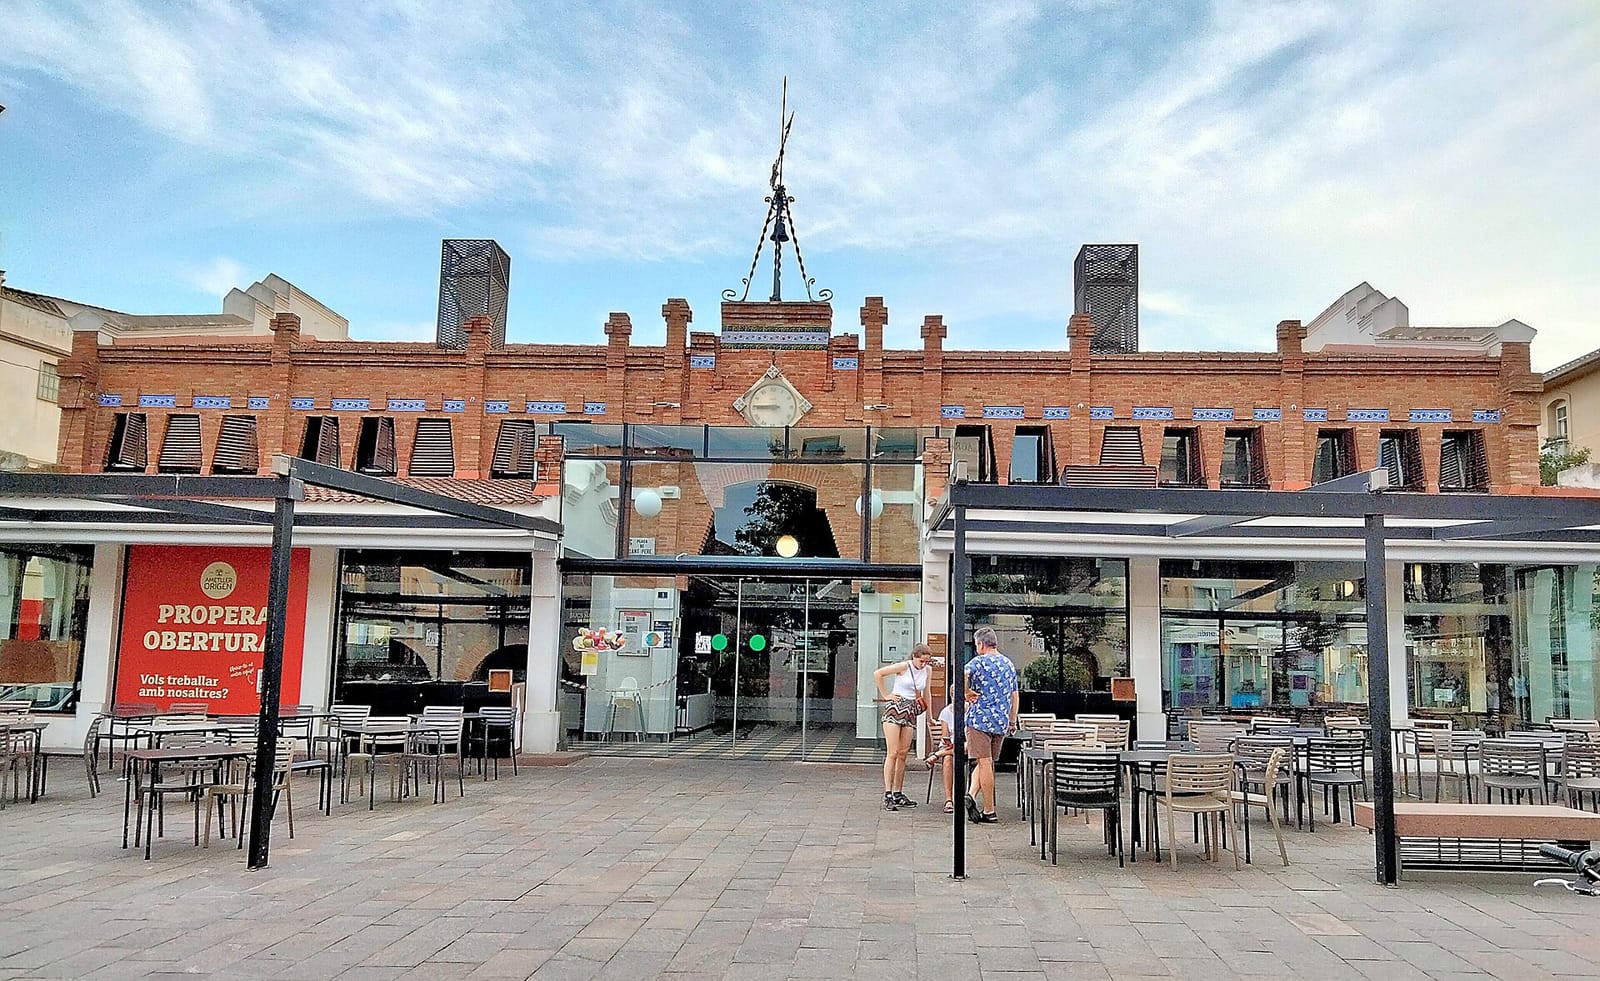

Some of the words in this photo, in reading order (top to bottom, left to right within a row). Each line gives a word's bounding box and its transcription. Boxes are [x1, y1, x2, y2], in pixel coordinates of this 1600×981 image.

[203, 582, 233, 590] ORIGEN
[157, 604, 267, 625] PROPERA
[140, 674, 165, 685] Vols
[166, 674, 219, 687] treballar
[138, 686, 165, 697] amb
[167, 687, 229, 699] nosaltres?
